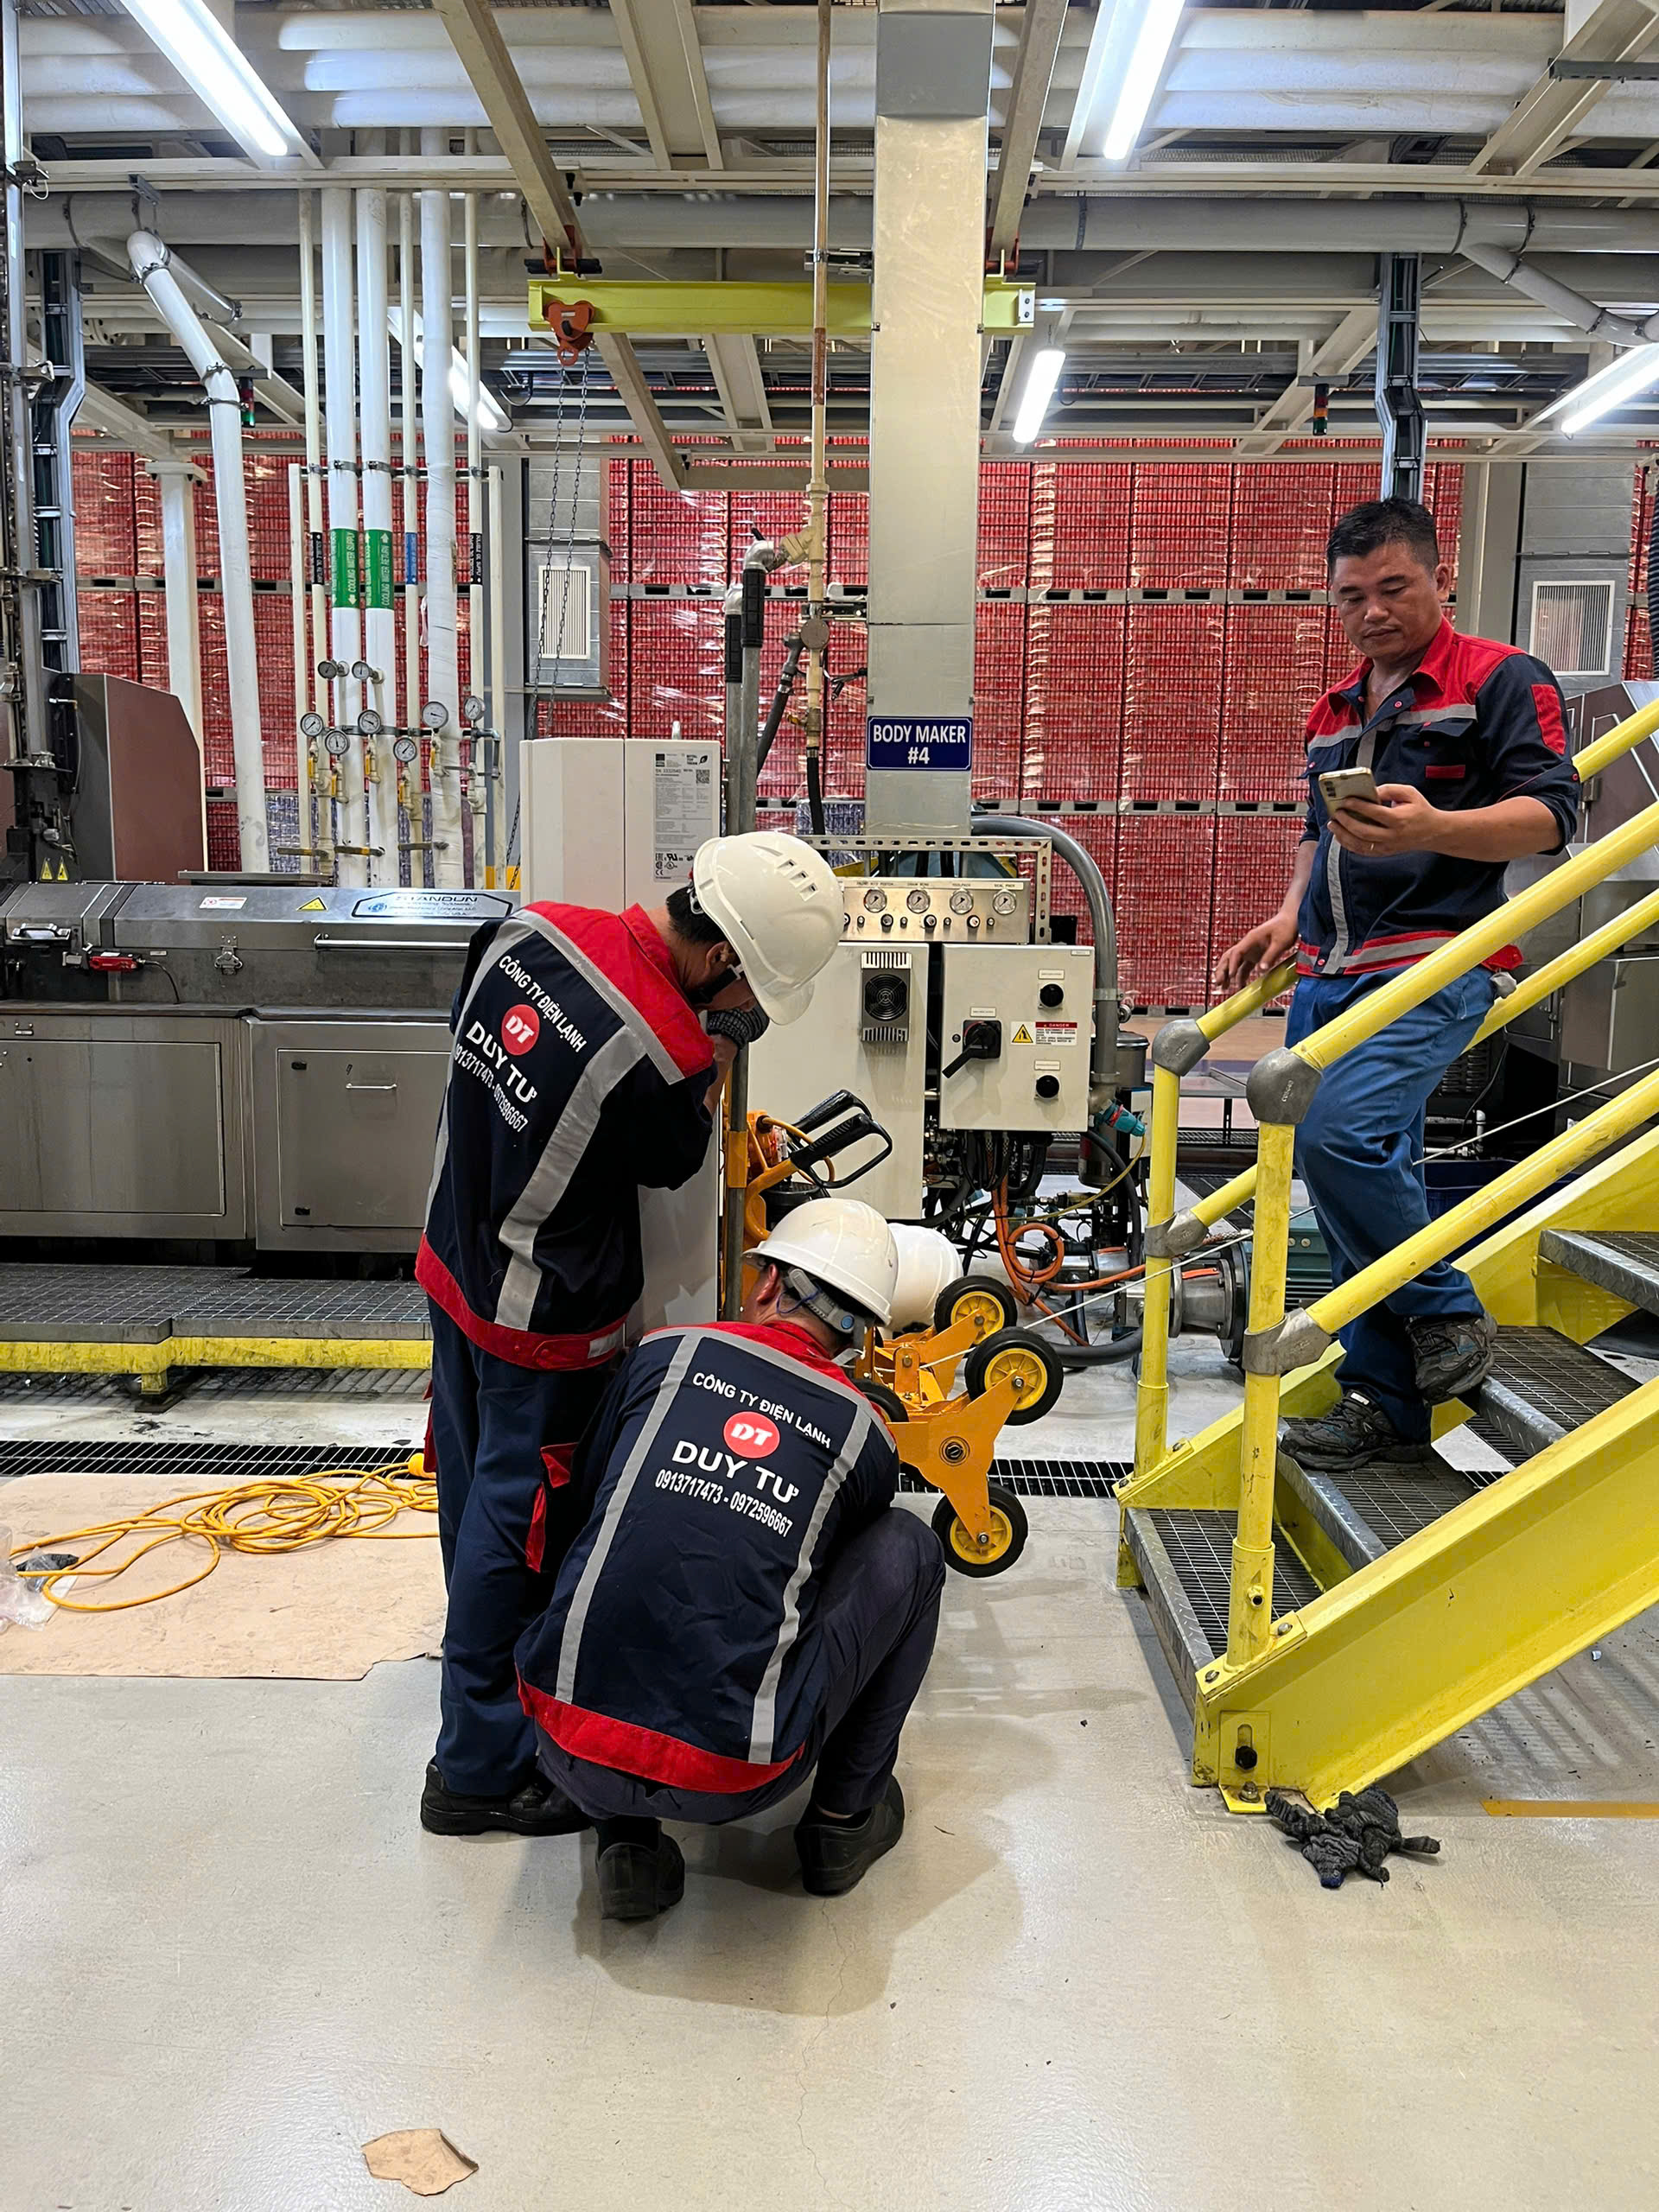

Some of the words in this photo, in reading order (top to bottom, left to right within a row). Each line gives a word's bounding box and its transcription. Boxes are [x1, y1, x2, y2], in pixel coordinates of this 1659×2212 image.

[346, 532, 355, 550] SUPPLY
[346, 551, 356, 569] WATER
[381, 545, 390, 565] RETURN
[346, 569, 357, 593] COOLING
[381, 566, 390, 582] WATER
[381, 582, 391, 606] COOLING
[873, 724, 912, 743] BODY
[915, 725, 966, 744] MAKER
[907, 746, 931, 765] #4
[499, 954, 529, 988] CÔNG
[527, 982, 545, 1001] TY
[538, 995, 564, 1028] ĐIỆN
[556, 1016, 588, 1053] LẠNH
[504, 1014, 535, 1044] DT
[466, 1020, 508, 1070] DUY
[505, 1064, 538, 1103] TƯ
[454, 1043, 493, 1089] 913717473
[493, 1083, 529, 1133] 0972596667
[692, 1372, 736, 1399] CÔNG
[740, 1389, 759, 1408] TY
[760, 1399, 795, 1425] ĐIỆN
[795, 1415, 831, 1449] LẠNH
[729, 1423, 773, 1446] DT
[671, 1440, 748, 1479] DUY
[754, 1465, 800, 1503] TƯ
[655, 1469, 724, 1504] 0913717473
[729, 1491, 793, 1538] 0972596667
